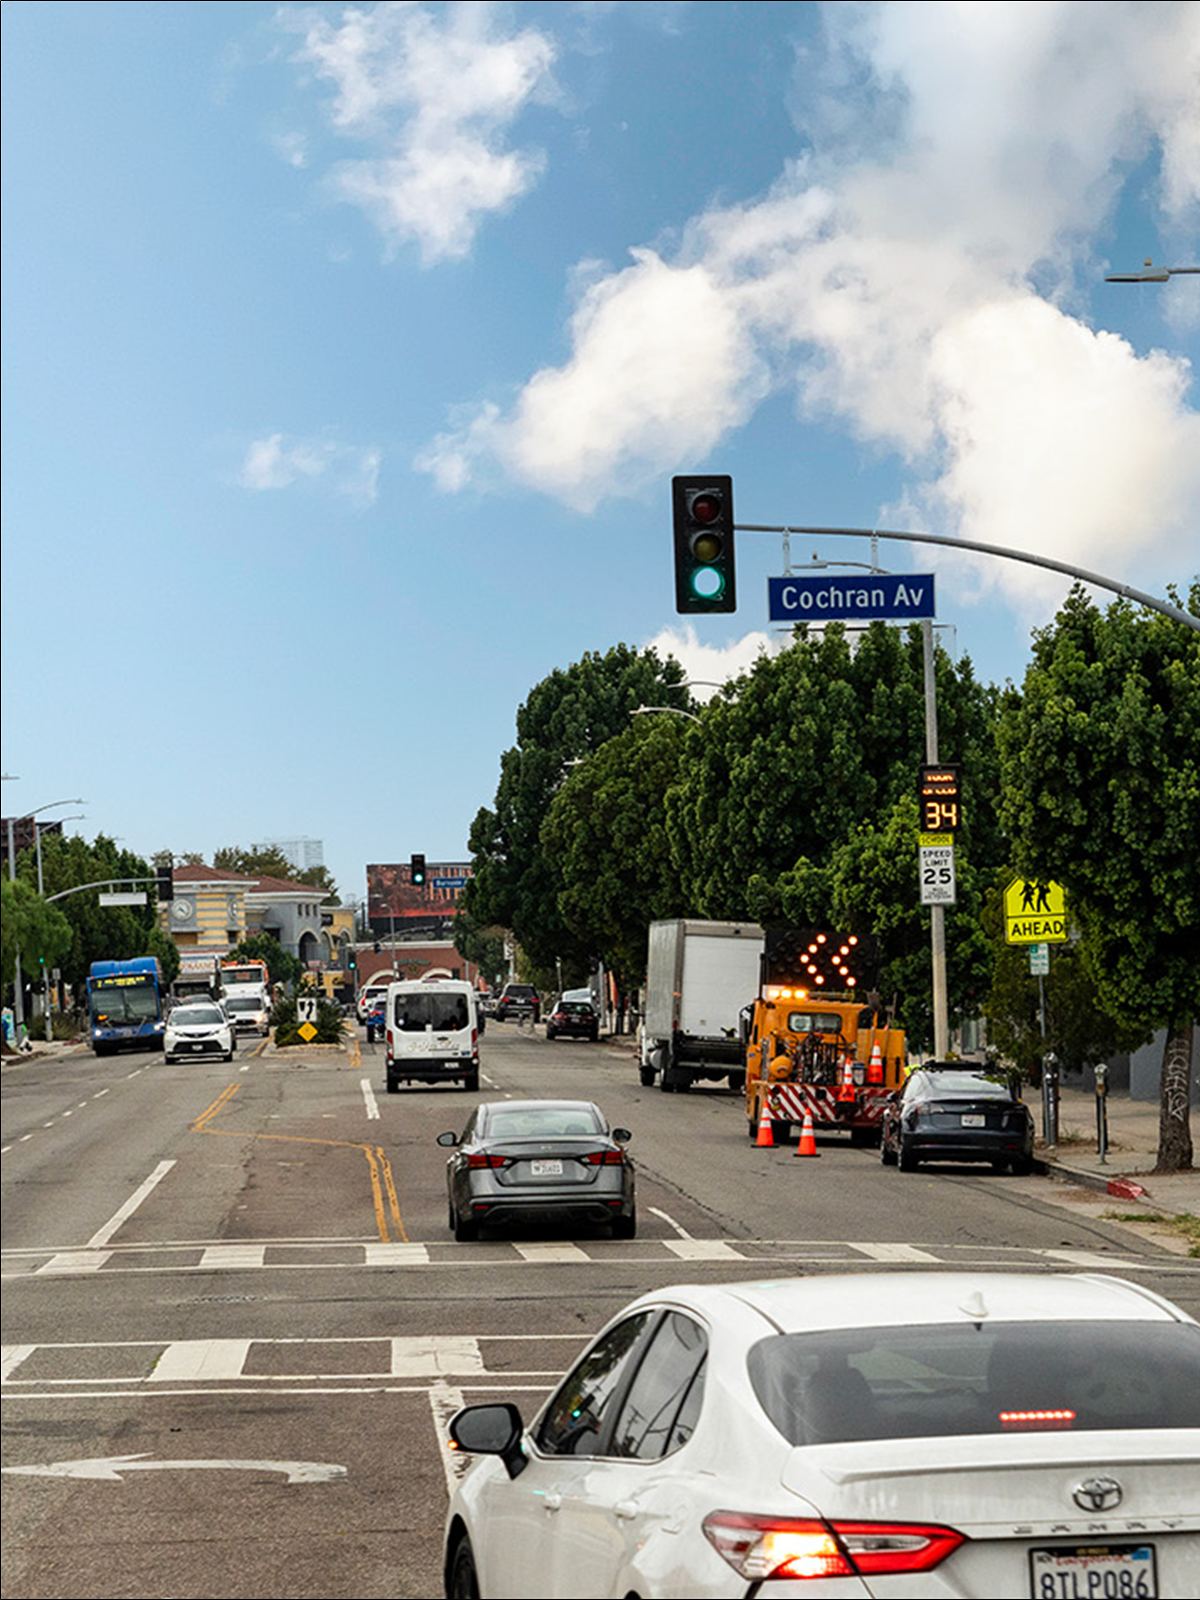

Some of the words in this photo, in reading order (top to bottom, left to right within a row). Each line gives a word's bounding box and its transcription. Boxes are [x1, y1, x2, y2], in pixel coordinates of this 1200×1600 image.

[781, 586, 885, 609] Cochran
[893, 585, 924, 607] Av
[926, 801, 958, 829] 34
[922, 850, 952, 858] SPEED
[925, 859, 949, 867] LIMIT
[923, 868, 952, 885] 25
[1011, 920, 1064, 936] AHEAD
[1040, 1568, 1149, 1599] 8TLP086
